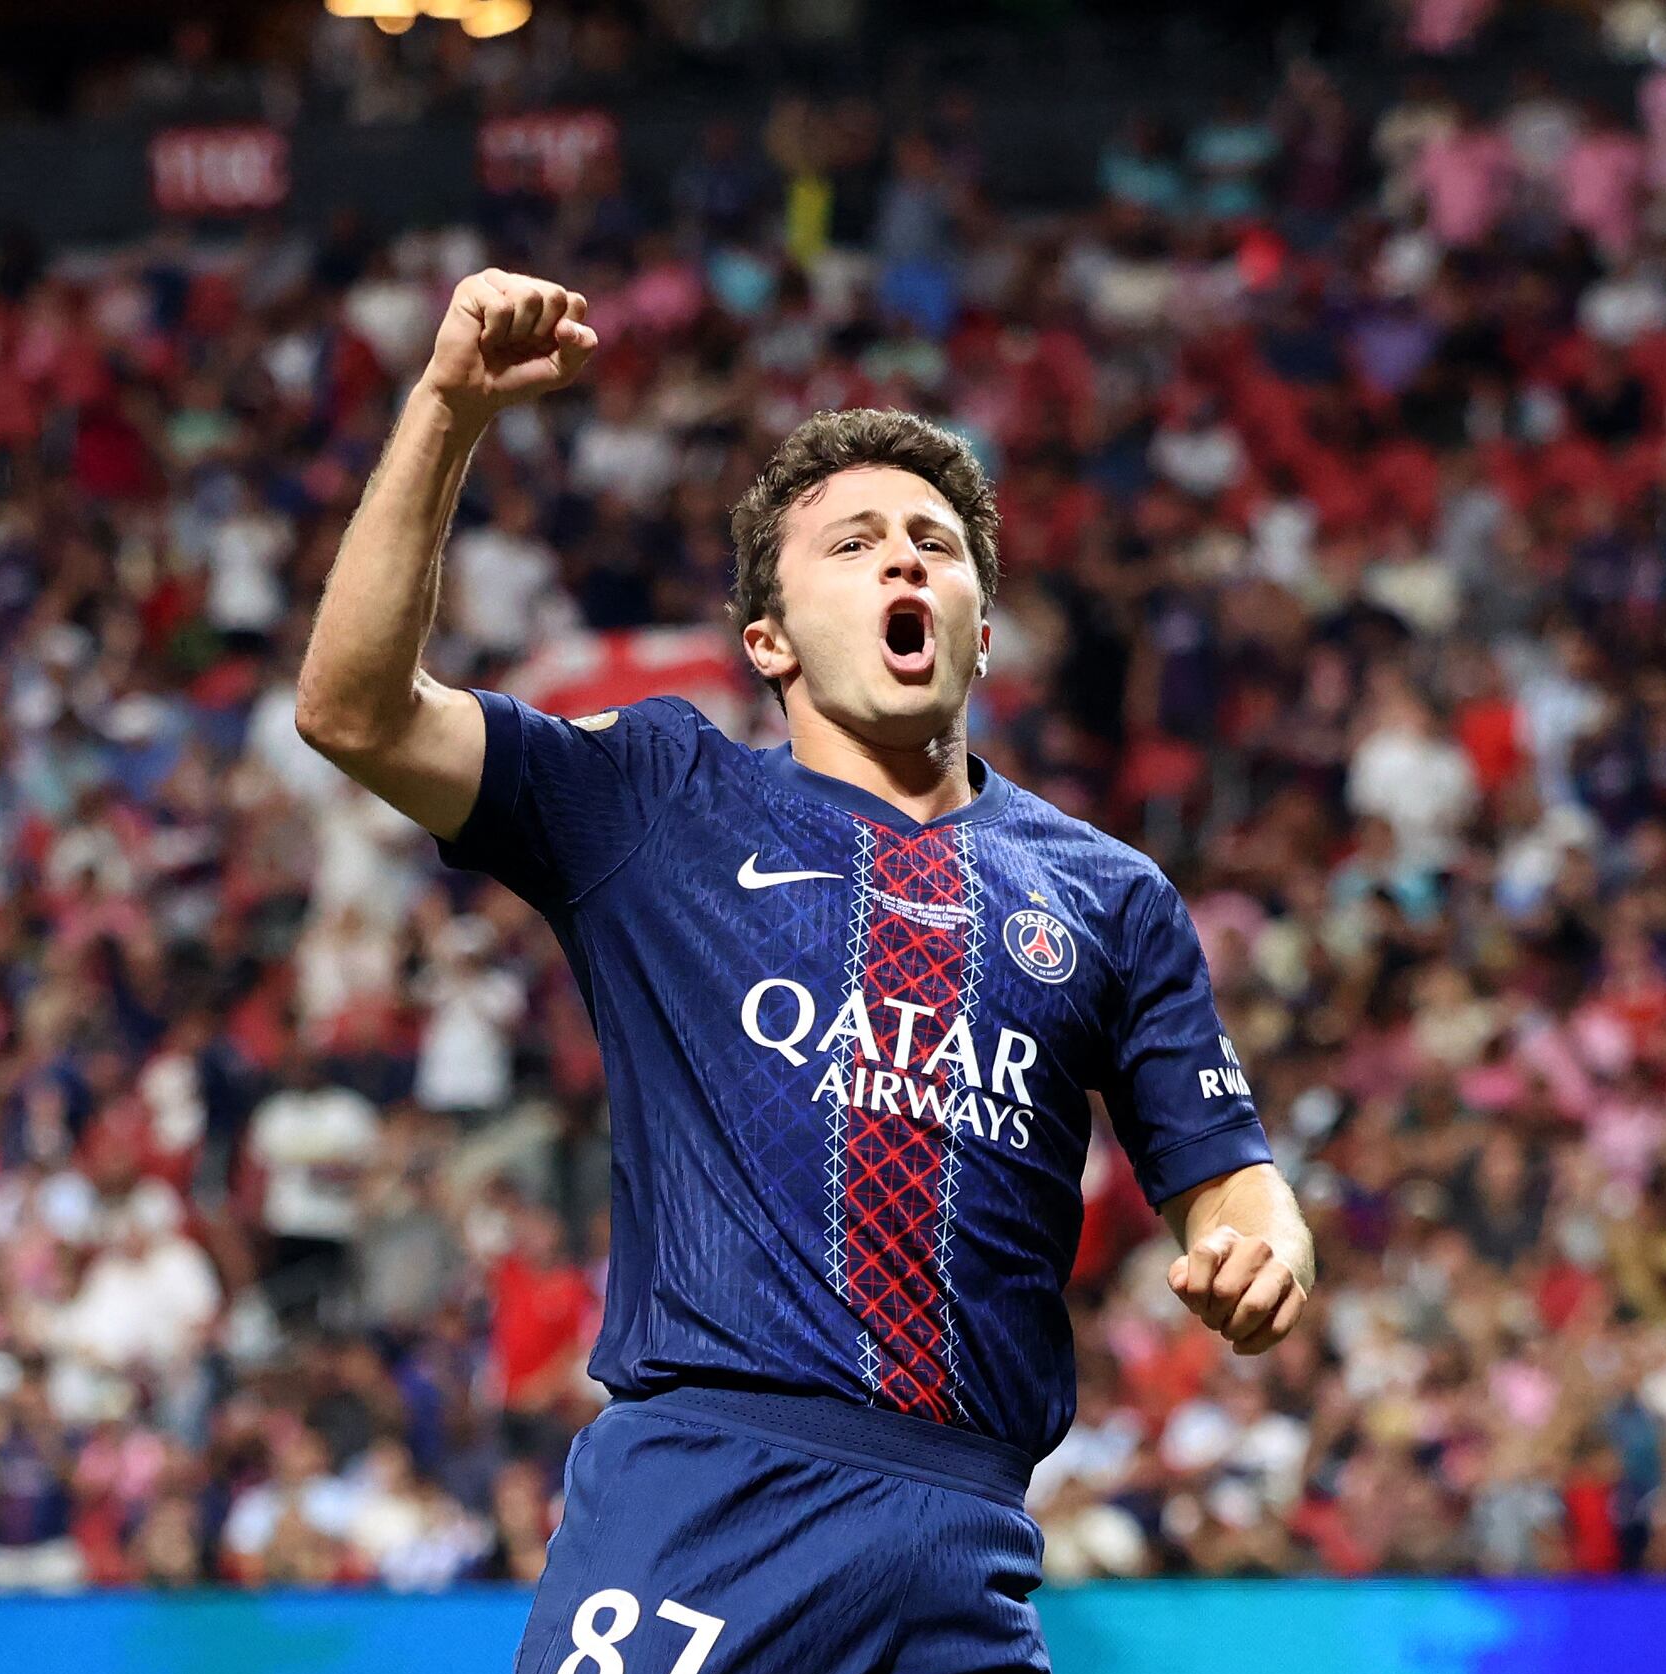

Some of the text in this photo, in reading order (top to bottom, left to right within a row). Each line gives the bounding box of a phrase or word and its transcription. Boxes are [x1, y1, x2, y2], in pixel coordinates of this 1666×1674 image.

[1015, 913, 1065, 938] PARIS
[740, 977, 1038, 1107] QATAR
[811, 1060, 1035, 1150] AIRWAYS
